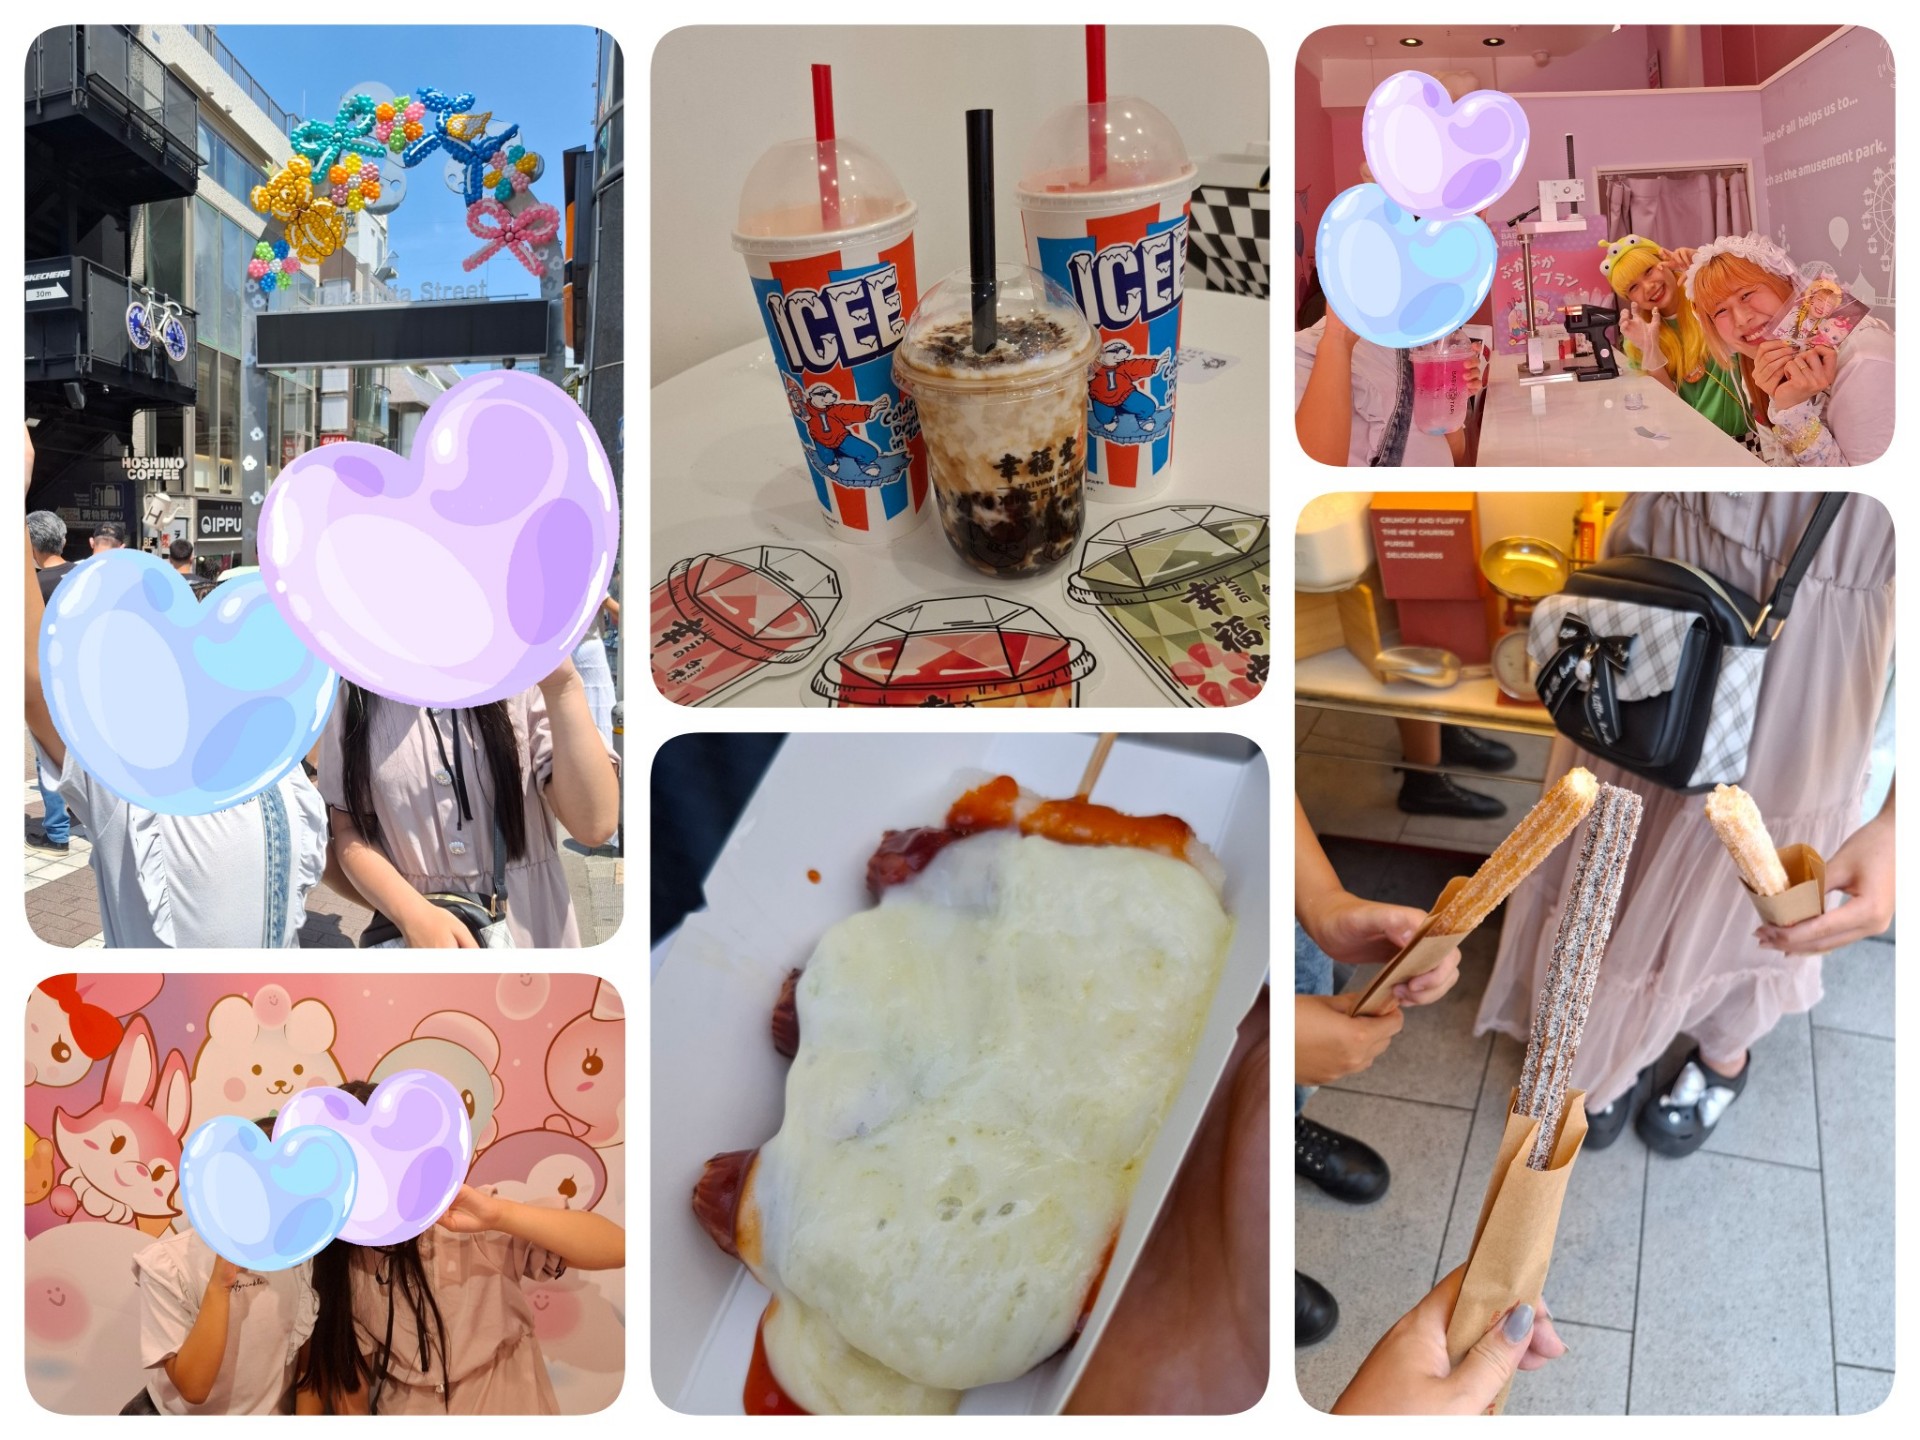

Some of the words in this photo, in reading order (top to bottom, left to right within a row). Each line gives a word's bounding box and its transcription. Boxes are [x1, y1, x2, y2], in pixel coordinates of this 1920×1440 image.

[1786, 120, 1796, 134] all
[1798, 109, 1822, 128] helps
[1824, 103, 1836, 116] us
[1837, 97, 1858, 111] to...
[1775, 174, 1782, 184] as
[1784, 168, 1797, 180] the
[1798, 149, 1853, 176] amusement
[1855, 139, 1887, 163] park.
[36, 290, 51, 298] 30m
[420, 279, 488, 301] Street
[768, 264, 906, 370] ICEE
[122, 457, 185, 469] HOSHINO
[127, 469, 180, 480] COFFEE
[1018, 475, 1056, 490] TAIWAN
[212, 517, 242, 532] IPPU
